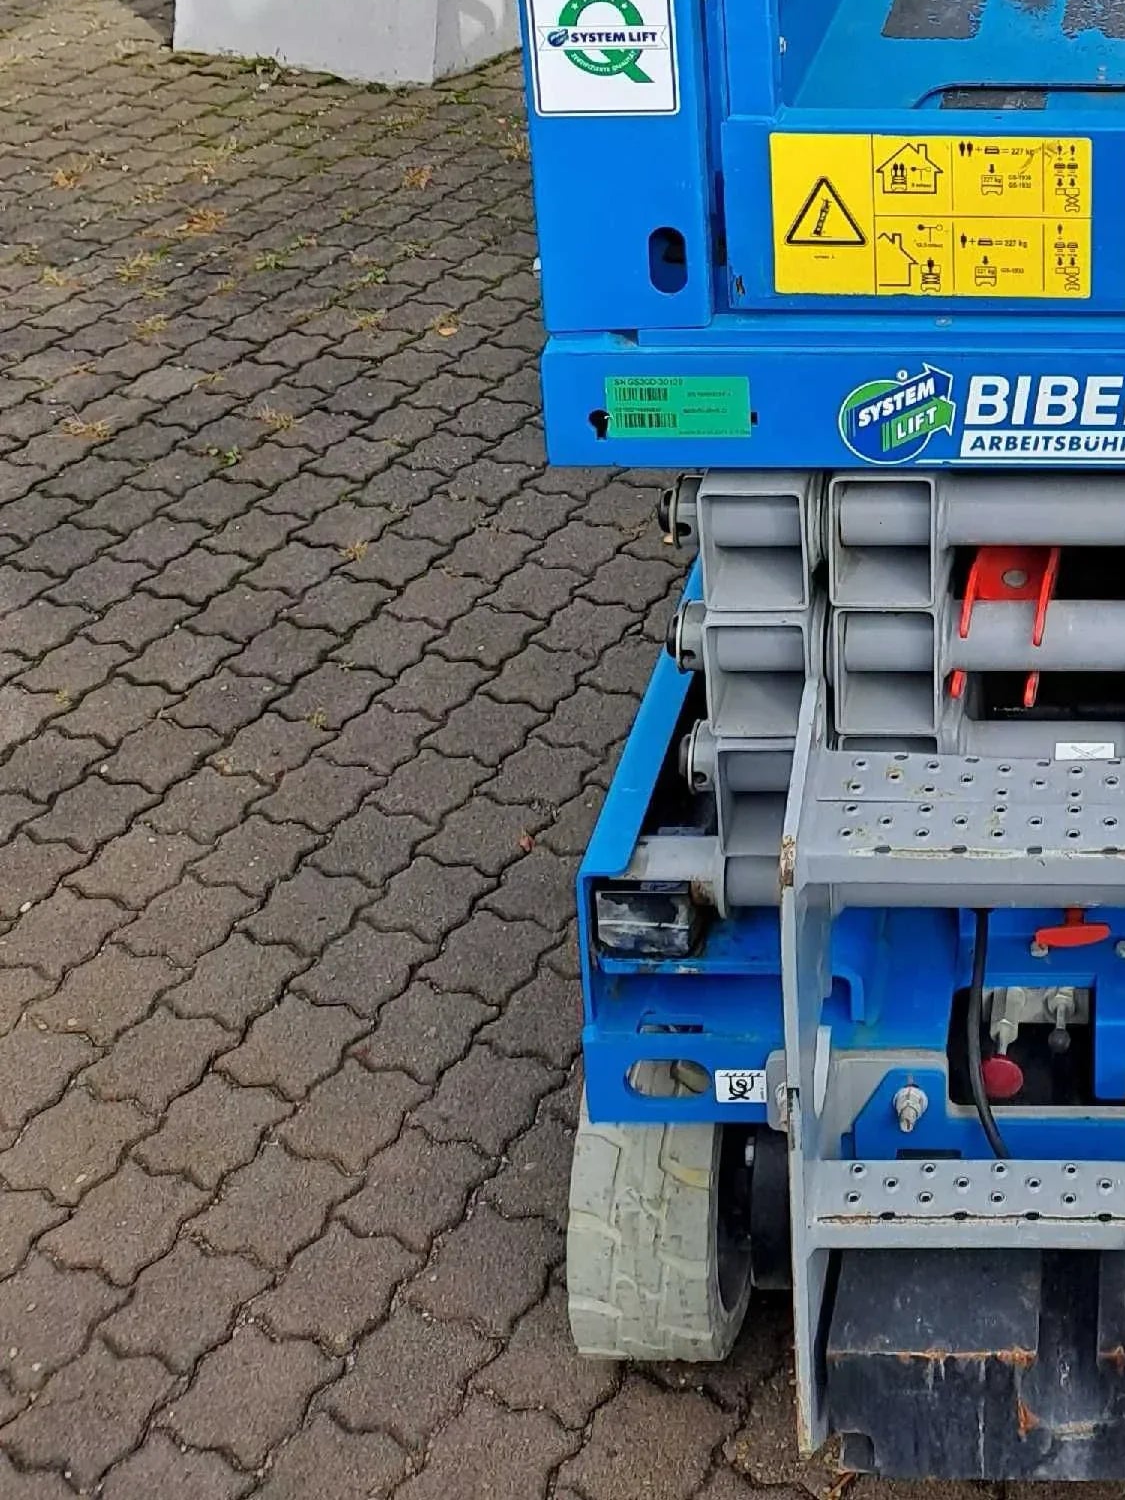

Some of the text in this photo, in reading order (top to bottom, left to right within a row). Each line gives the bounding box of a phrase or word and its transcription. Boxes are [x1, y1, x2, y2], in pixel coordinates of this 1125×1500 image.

[570, 32, 657, 43] SYSTEM LIFT
[858, 377, 935, 427] SYSTEM
[897, 406, 938, 439] LIFT
